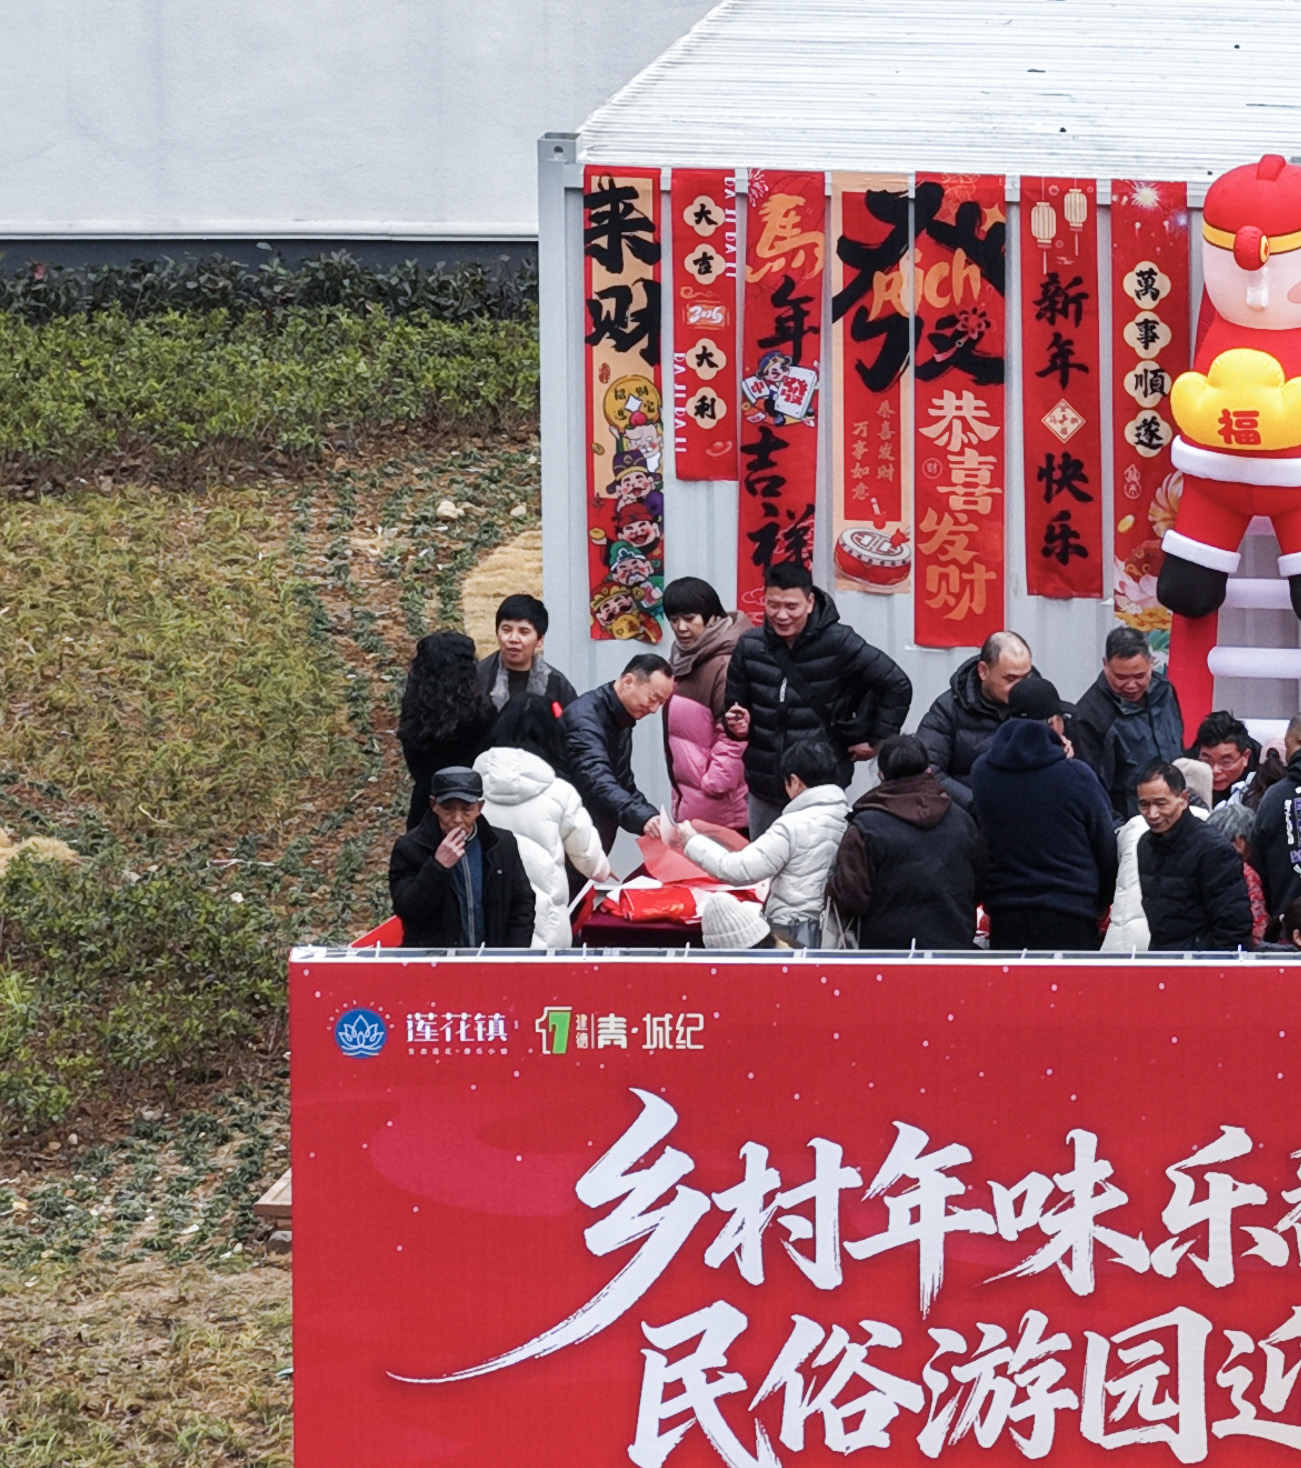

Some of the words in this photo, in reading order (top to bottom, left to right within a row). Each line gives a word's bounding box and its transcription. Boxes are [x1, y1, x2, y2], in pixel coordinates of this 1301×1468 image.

[584, 173, 661, 366] 来财
[1217, 409, 1262, 446] 福
[918, 389, 1003, 621] 恭喜发财
[406, 1012, 508, 1042] 莲花镇
